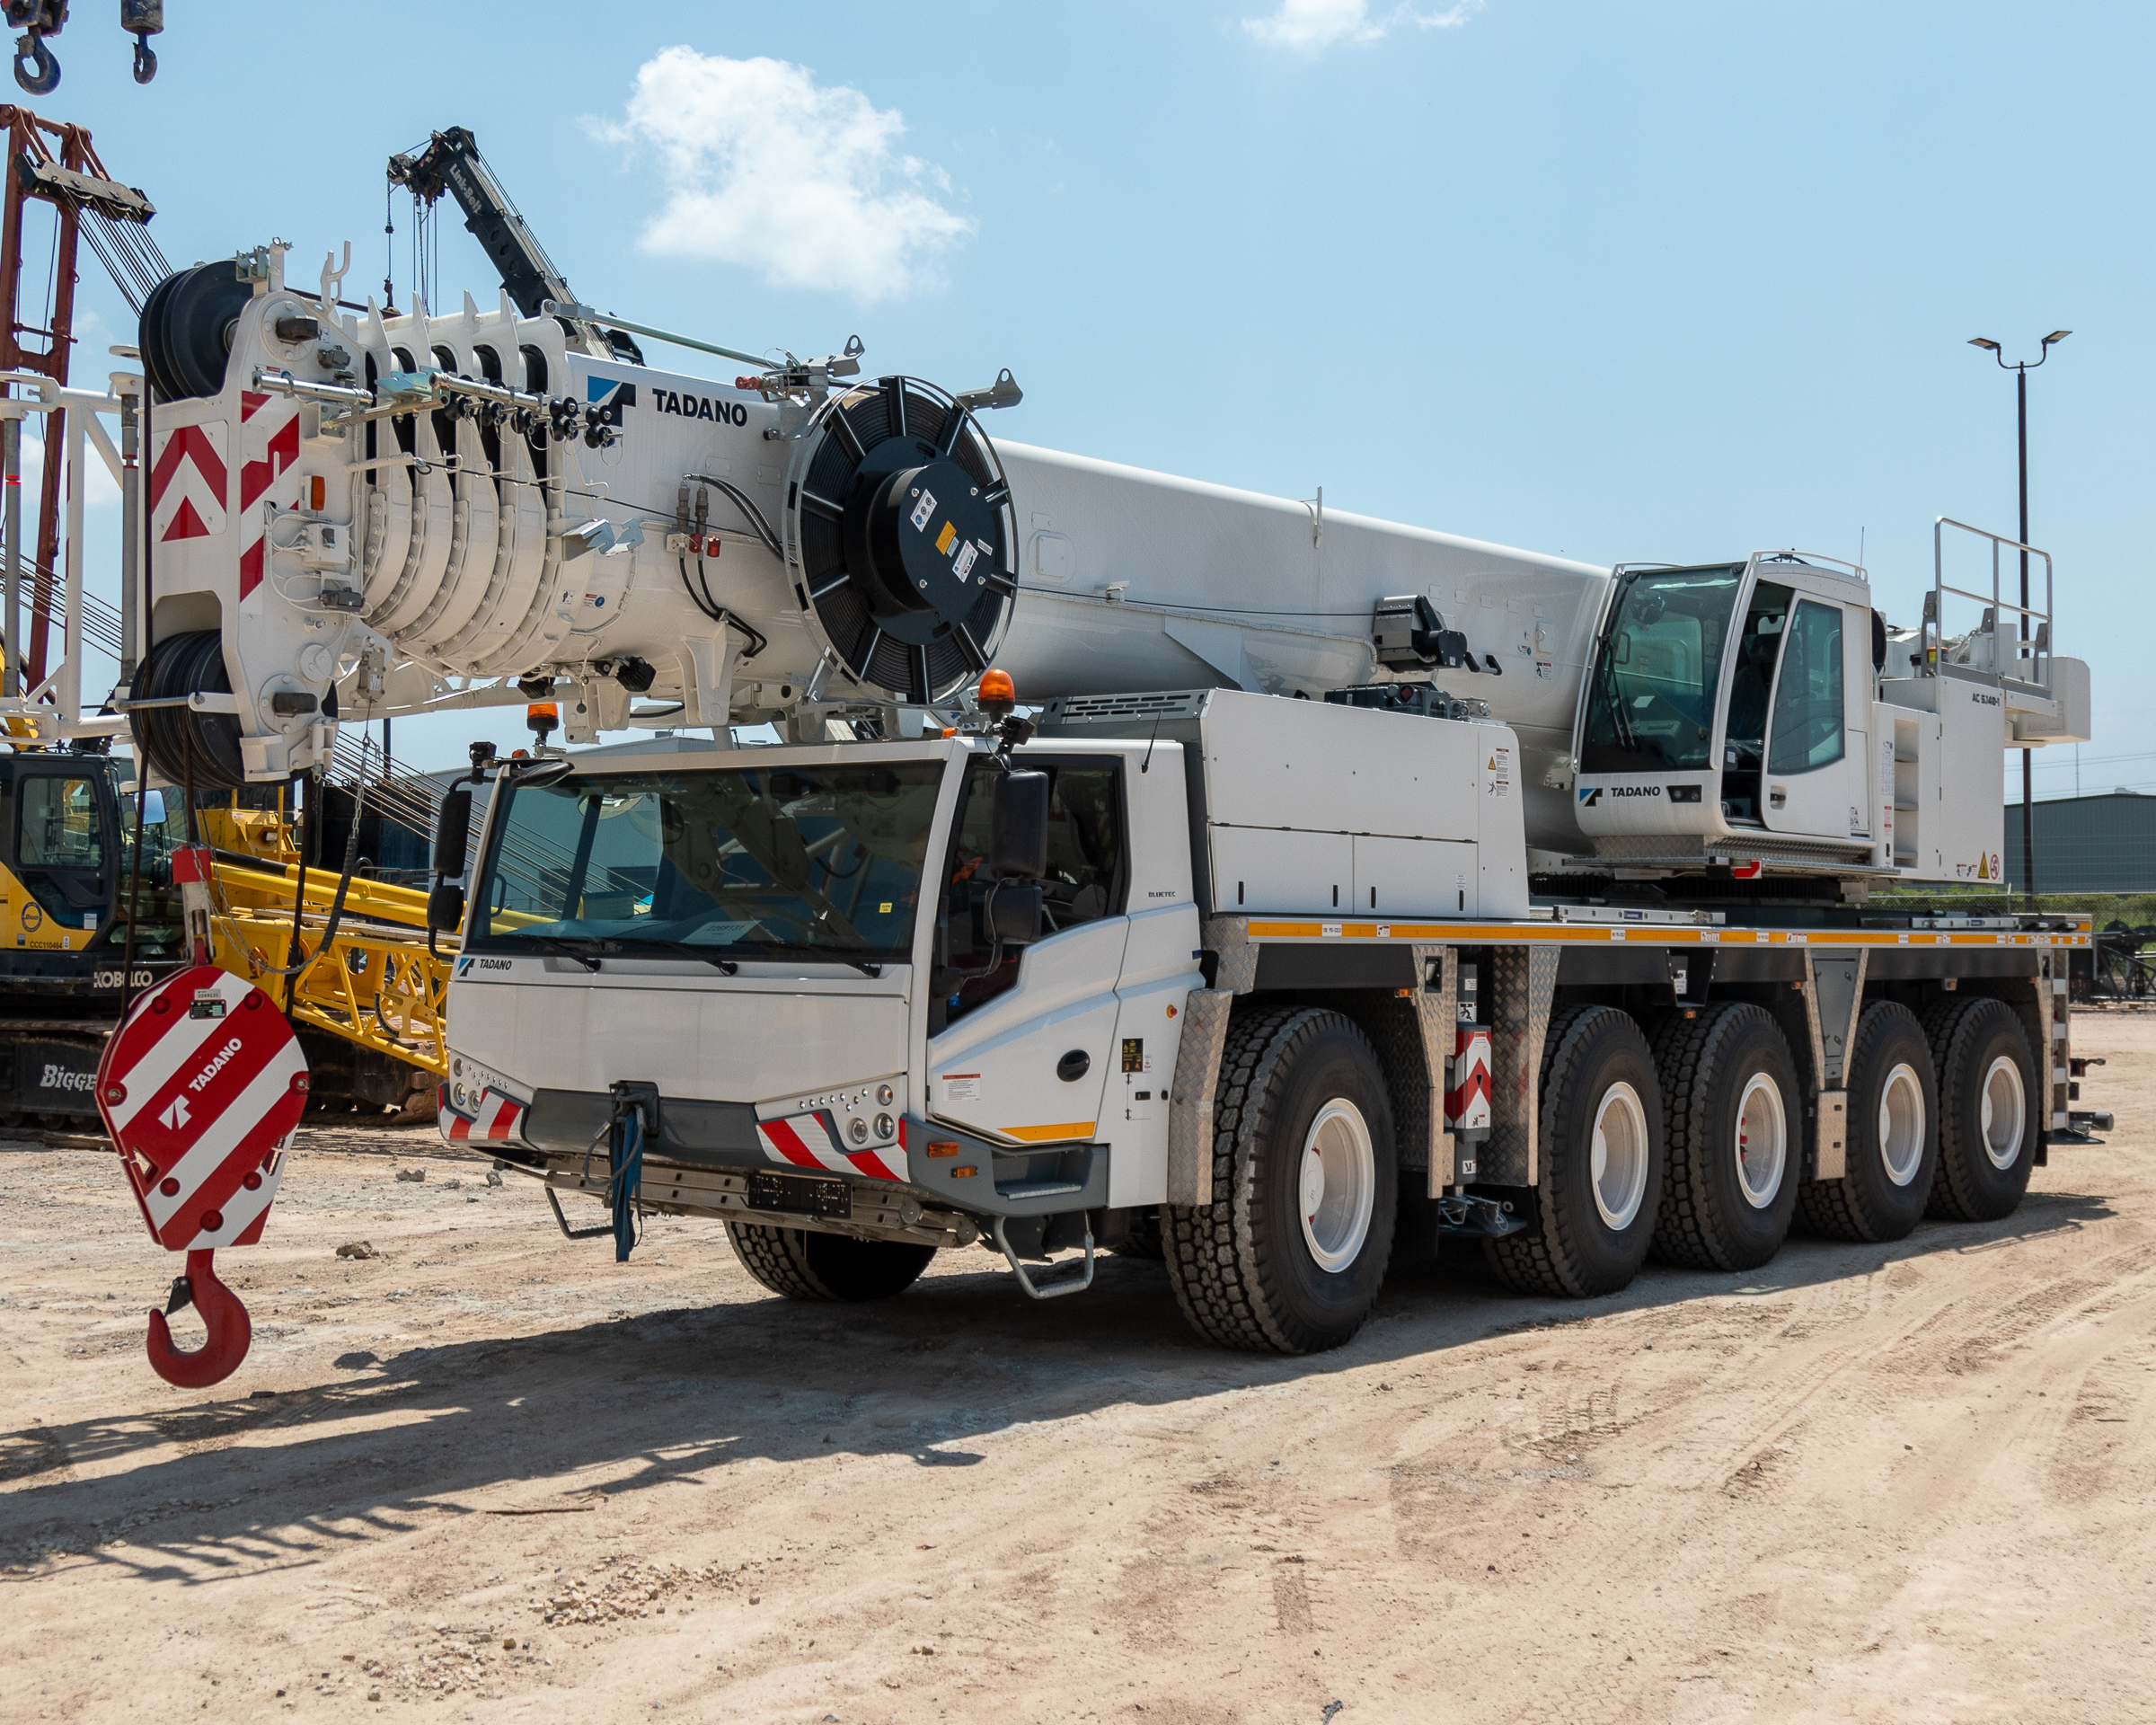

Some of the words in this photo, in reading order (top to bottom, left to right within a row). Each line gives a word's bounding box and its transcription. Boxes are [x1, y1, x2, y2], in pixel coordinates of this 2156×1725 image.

[450, 164, 482, 214] Link-Belt
[652, 387, 747, 428] TADANO
[1972, 693, 1980, 703] AC
[1611, 786, 1661, 797] TADANO
[480, 959, 512, 970] TADANO
[188, 1038, 243, 1092] TADANO
